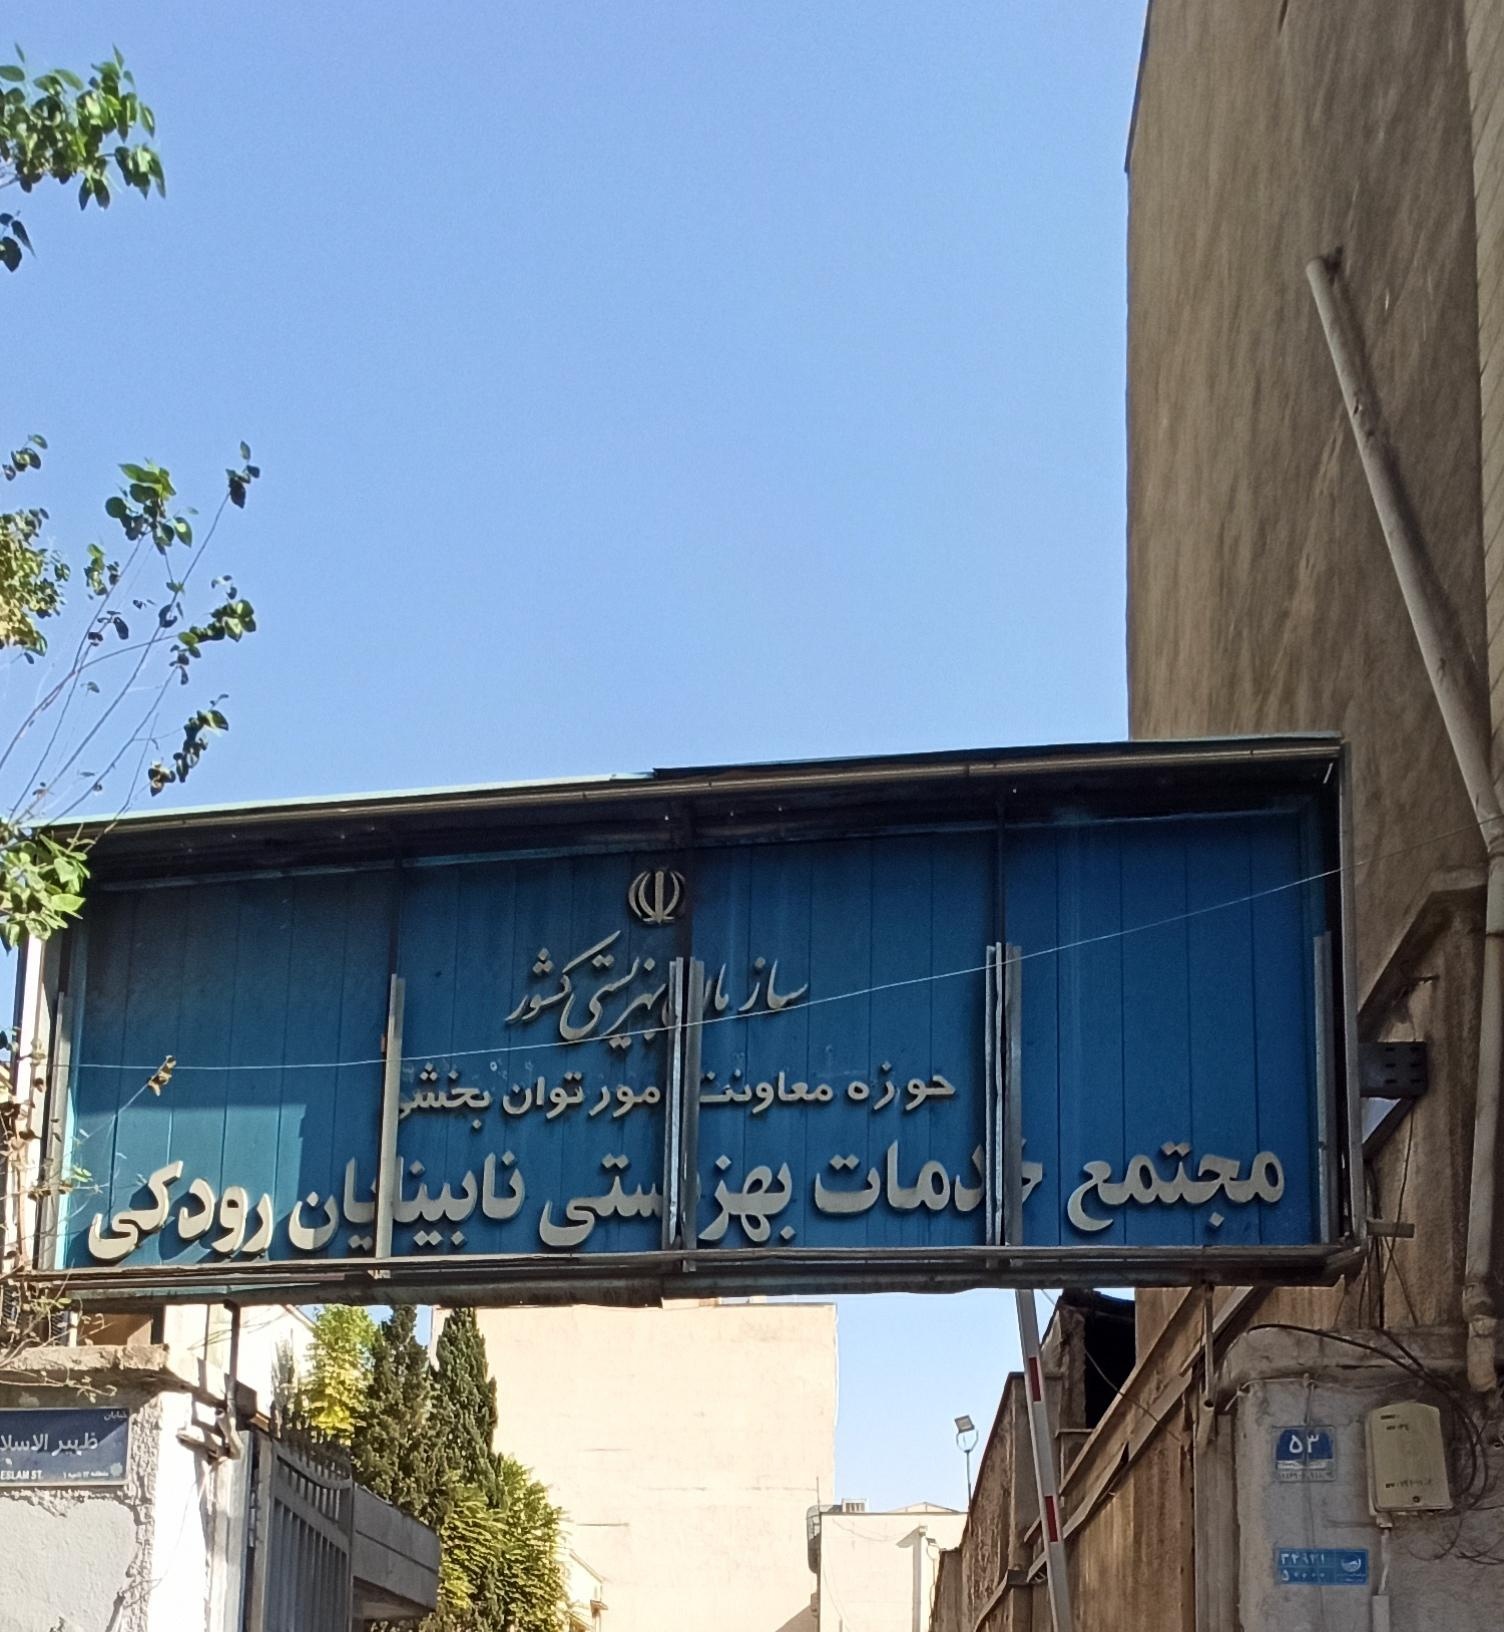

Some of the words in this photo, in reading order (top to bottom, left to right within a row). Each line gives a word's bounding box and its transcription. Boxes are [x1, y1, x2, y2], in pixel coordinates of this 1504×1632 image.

[504, 930, 621, 1022] کشور
[590, 1084, 661, 1118] مور
[848, 1060, 956, 1112] حوزه
[1067, 1140, 1287, 1233] مجتمع
[87, 1159, 273, 1261] رودکی
[0, 1433, 49, 1452] الاسلا
[51, 1432, 99, 1457] ظهیر
[1289, 1434, 1320, 1454] ۵۳
